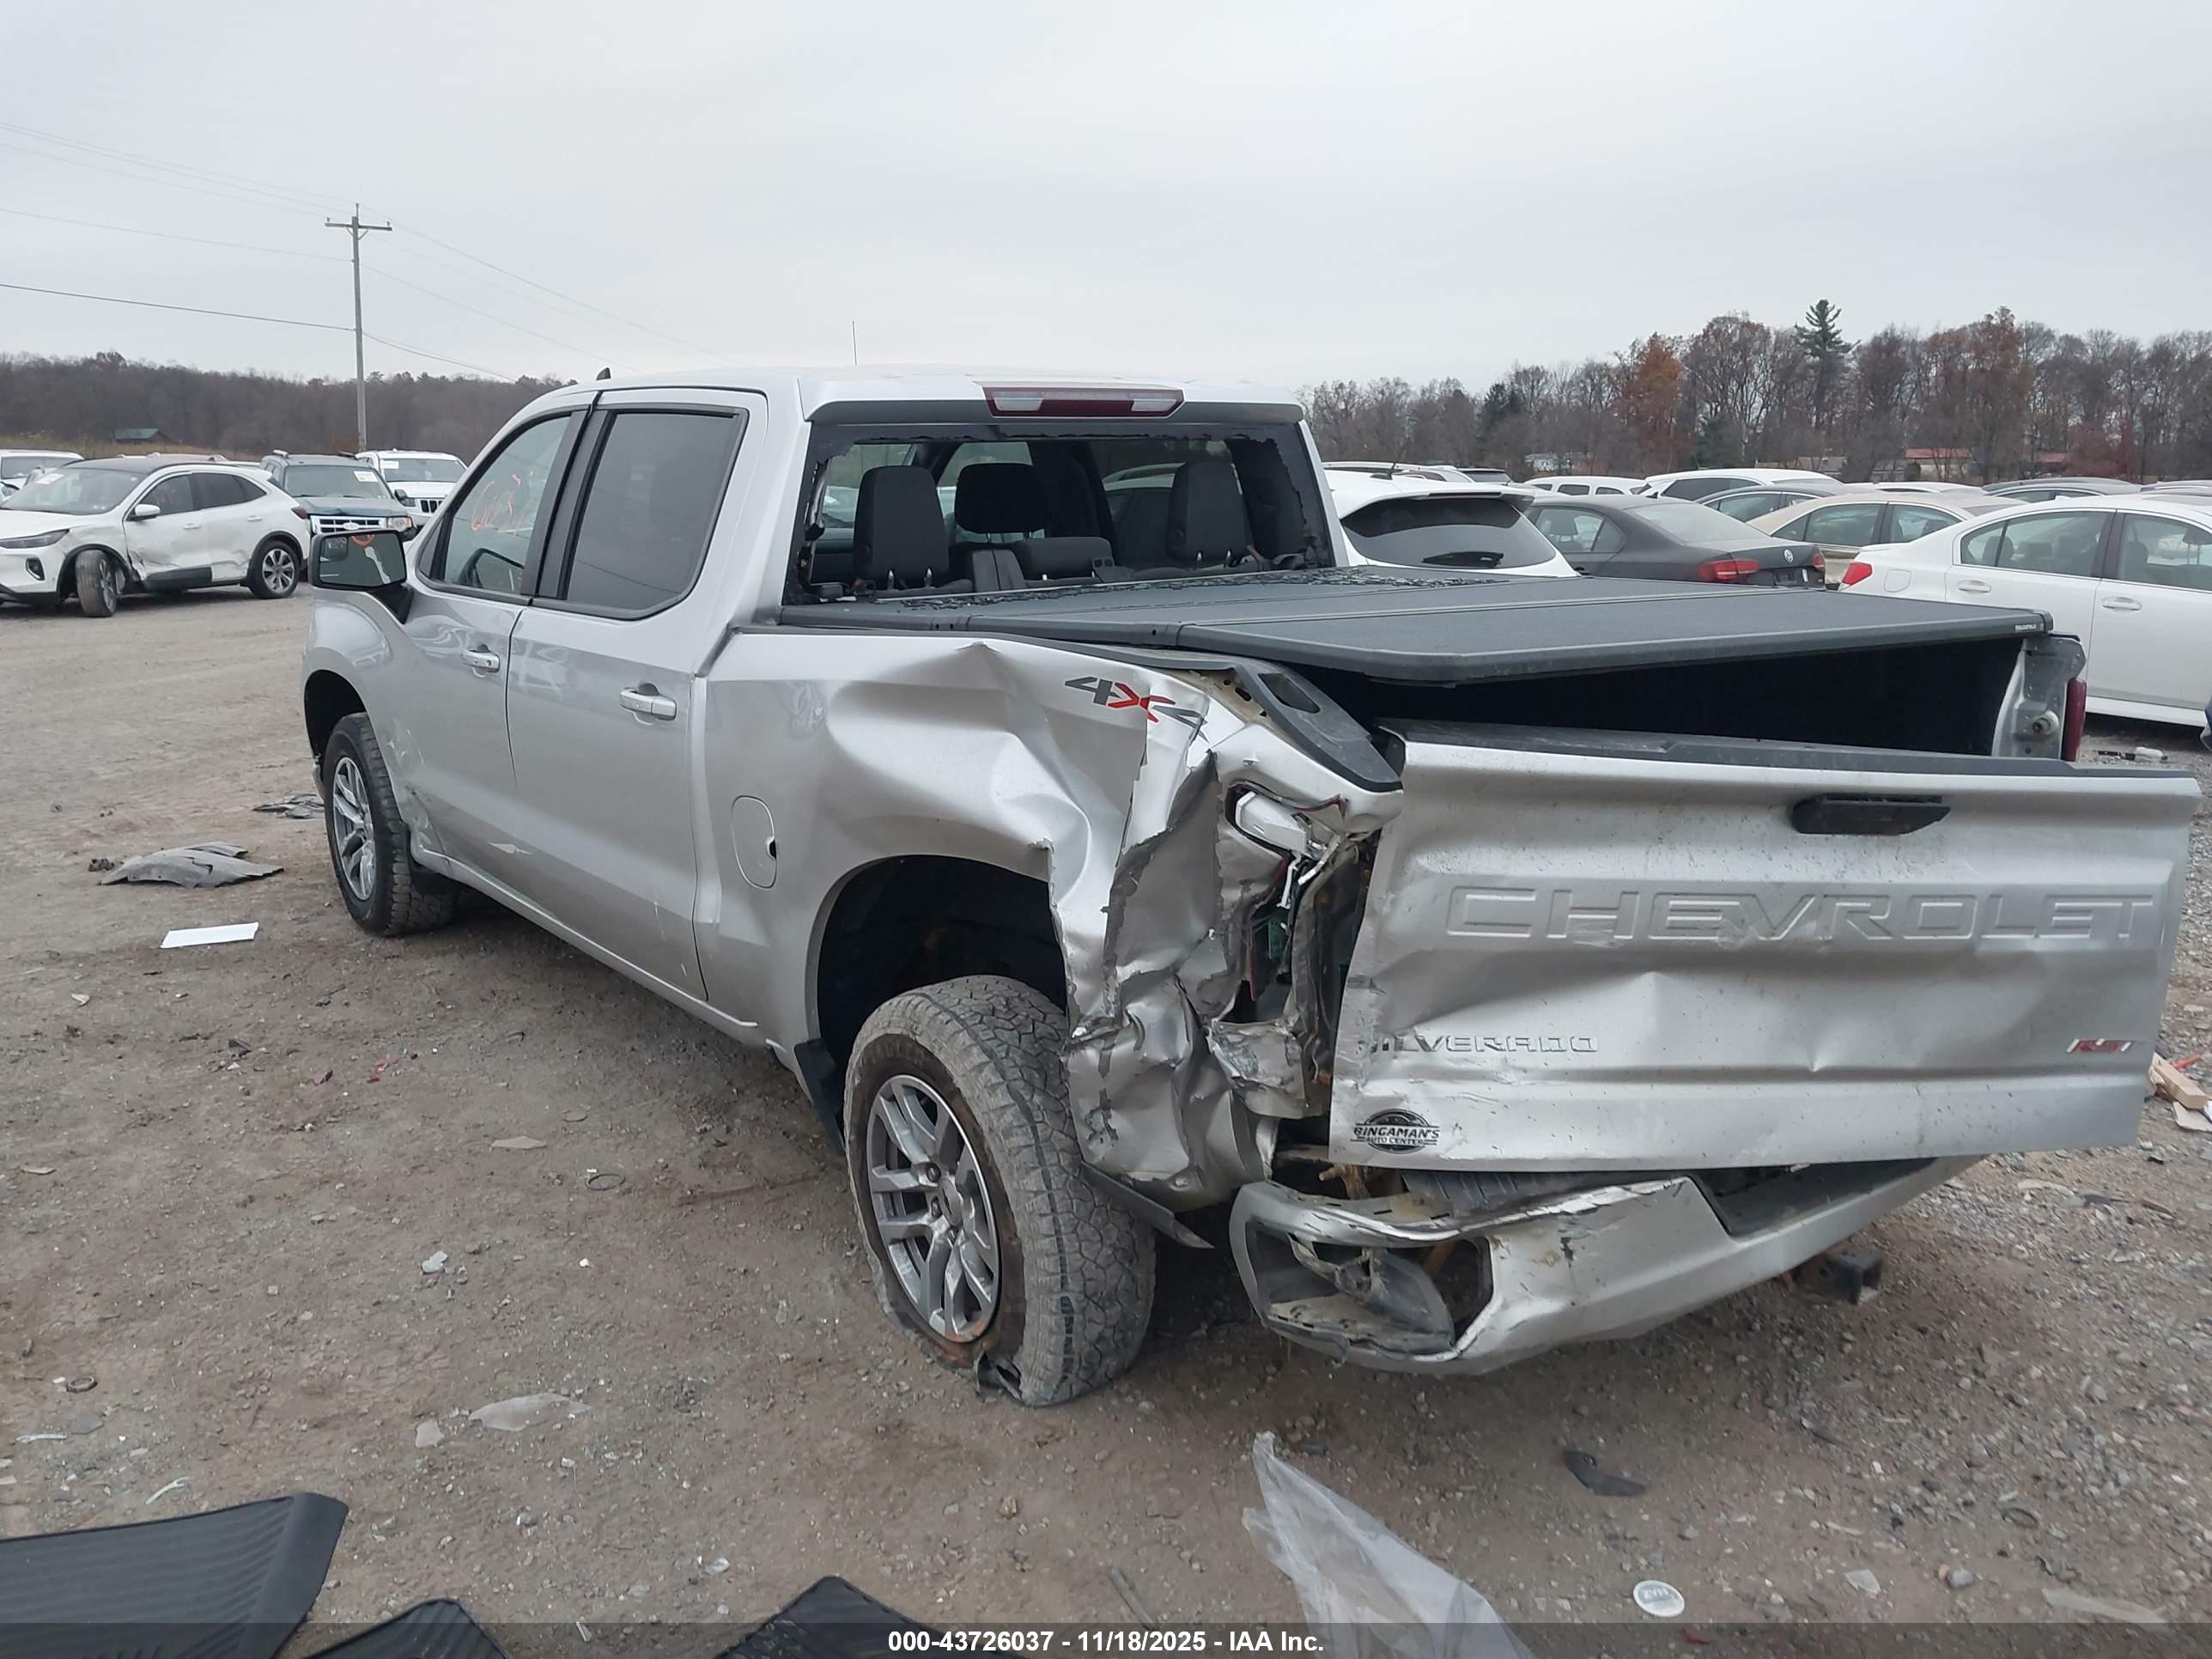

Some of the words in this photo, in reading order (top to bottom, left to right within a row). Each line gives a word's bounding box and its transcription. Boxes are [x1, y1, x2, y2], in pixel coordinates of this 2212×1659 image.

[1064, 676, 1210, 746] 4X4
[1446, 887, 2155, 941] CHEVROLET
[1370, 1035, 1598, 1053] ILVERADO
[1353, 1127, 1441, 1139] BINGAMAN'S
[1389, 1137, 1424, 1146] CENTER
